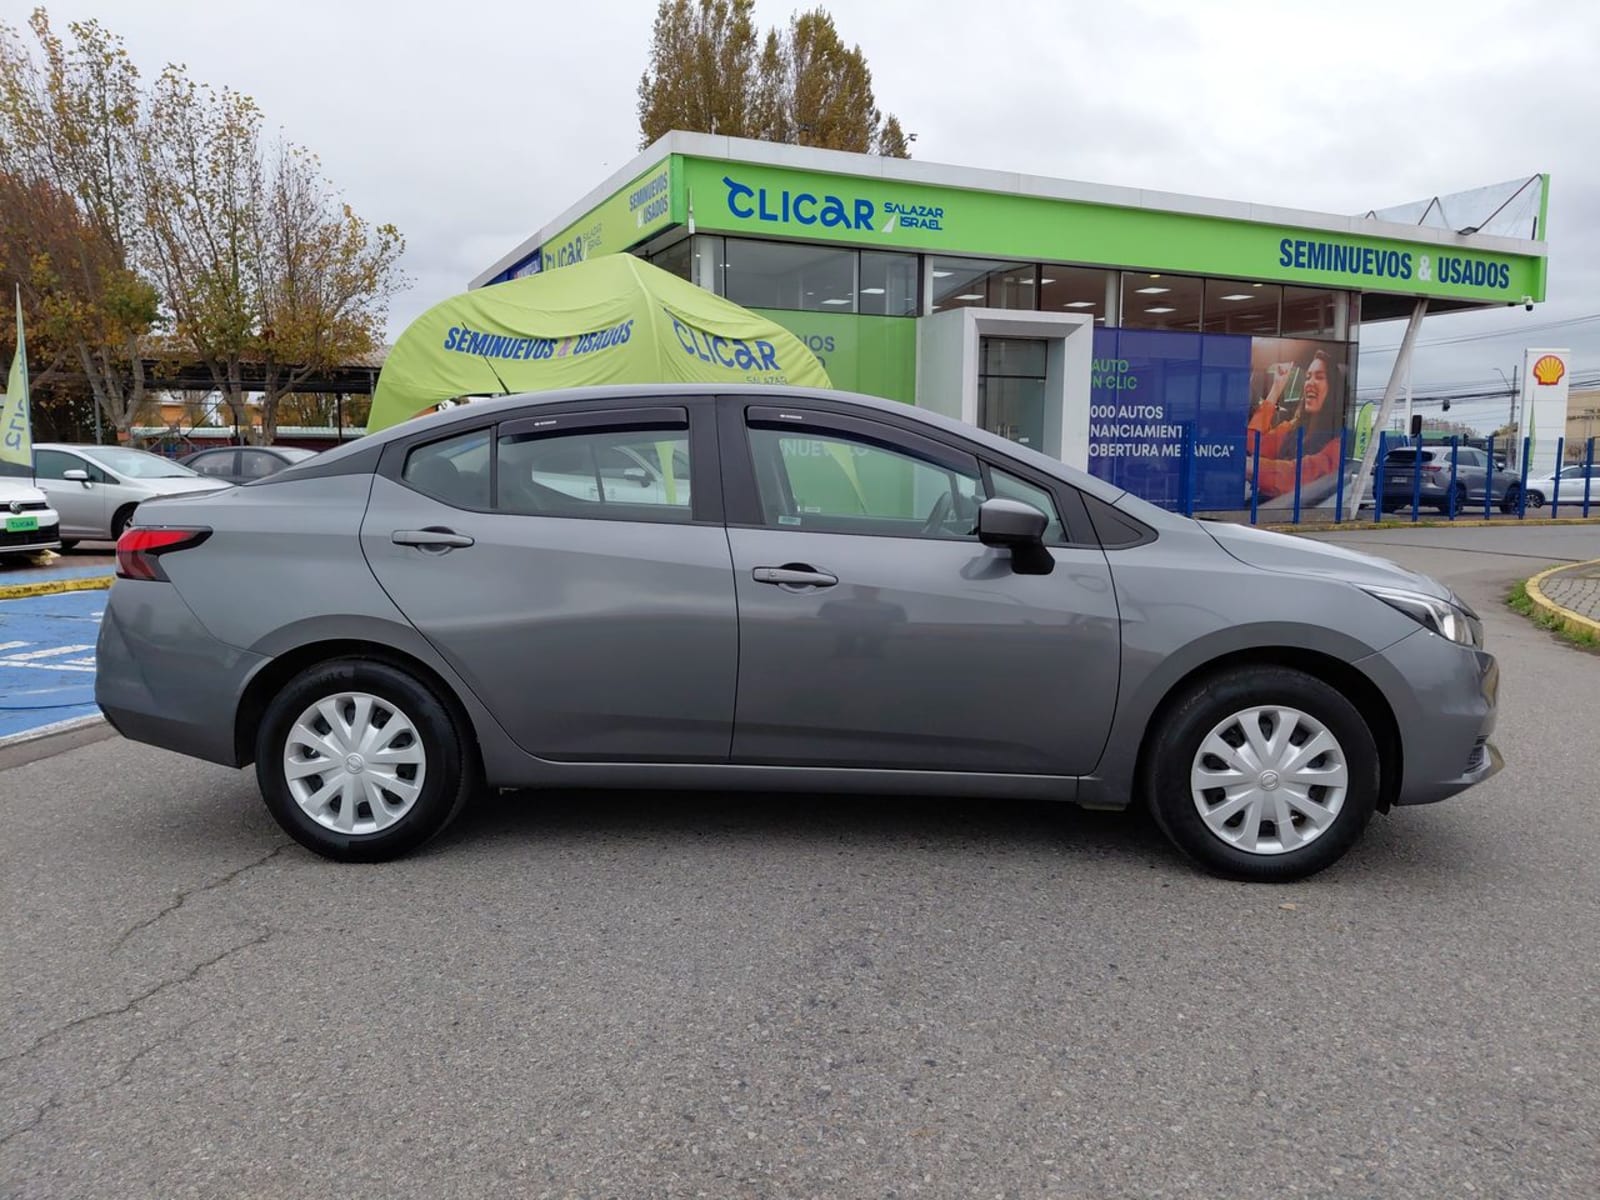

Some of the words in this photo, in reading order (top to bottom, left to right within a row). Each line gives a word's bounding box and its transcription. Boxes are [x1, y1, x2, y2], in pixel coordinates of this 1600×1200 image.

[884, 202, 944, 218] SALAZAR
[899, 216, 943, 231] ISRAEL
[1279, 238, 1412, 280] SEMINUEVOS
[1417, 255, 1432, 281] &
[1437, 256, 1510, 289] USADOS
[443, 327, 558, 359] SEMINUEVOS
[572, 319, 634, 355] USADOS
[1091, 359, 1129, 373] AUTO
[1105, 376, 1138, 390] CLIC
[1090, 405, 1116, 419] 000
[1118, 405, 1164, 419] AUTOS
[1089, 443, 1160, 457] OBERTURA
